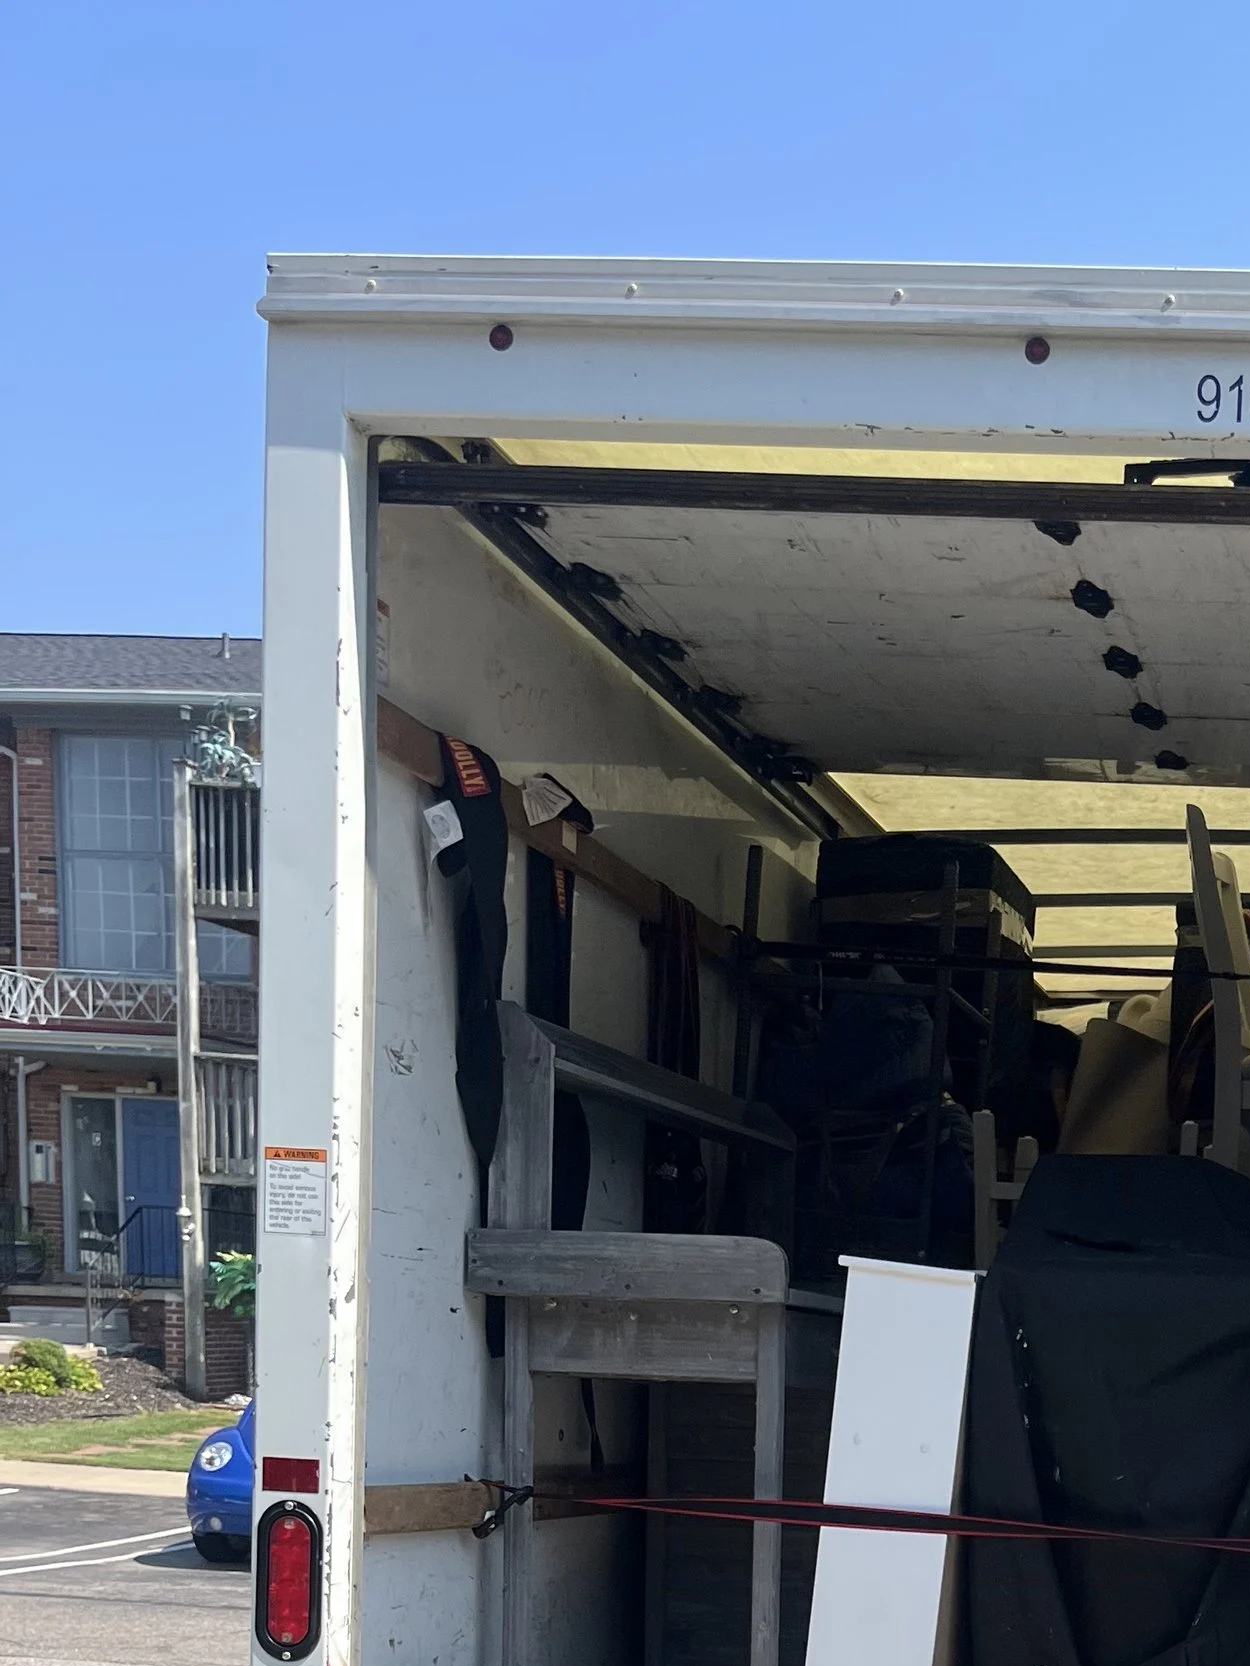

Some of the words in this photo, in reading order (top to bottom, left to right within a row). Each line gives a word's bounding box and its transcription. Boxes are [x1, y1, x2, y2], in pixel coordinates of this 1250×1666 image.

[283, 1150, 320, 1160] WARNING
[269, 1182, 277, 1190] To
[269, 1207, 294, 1215] entering
